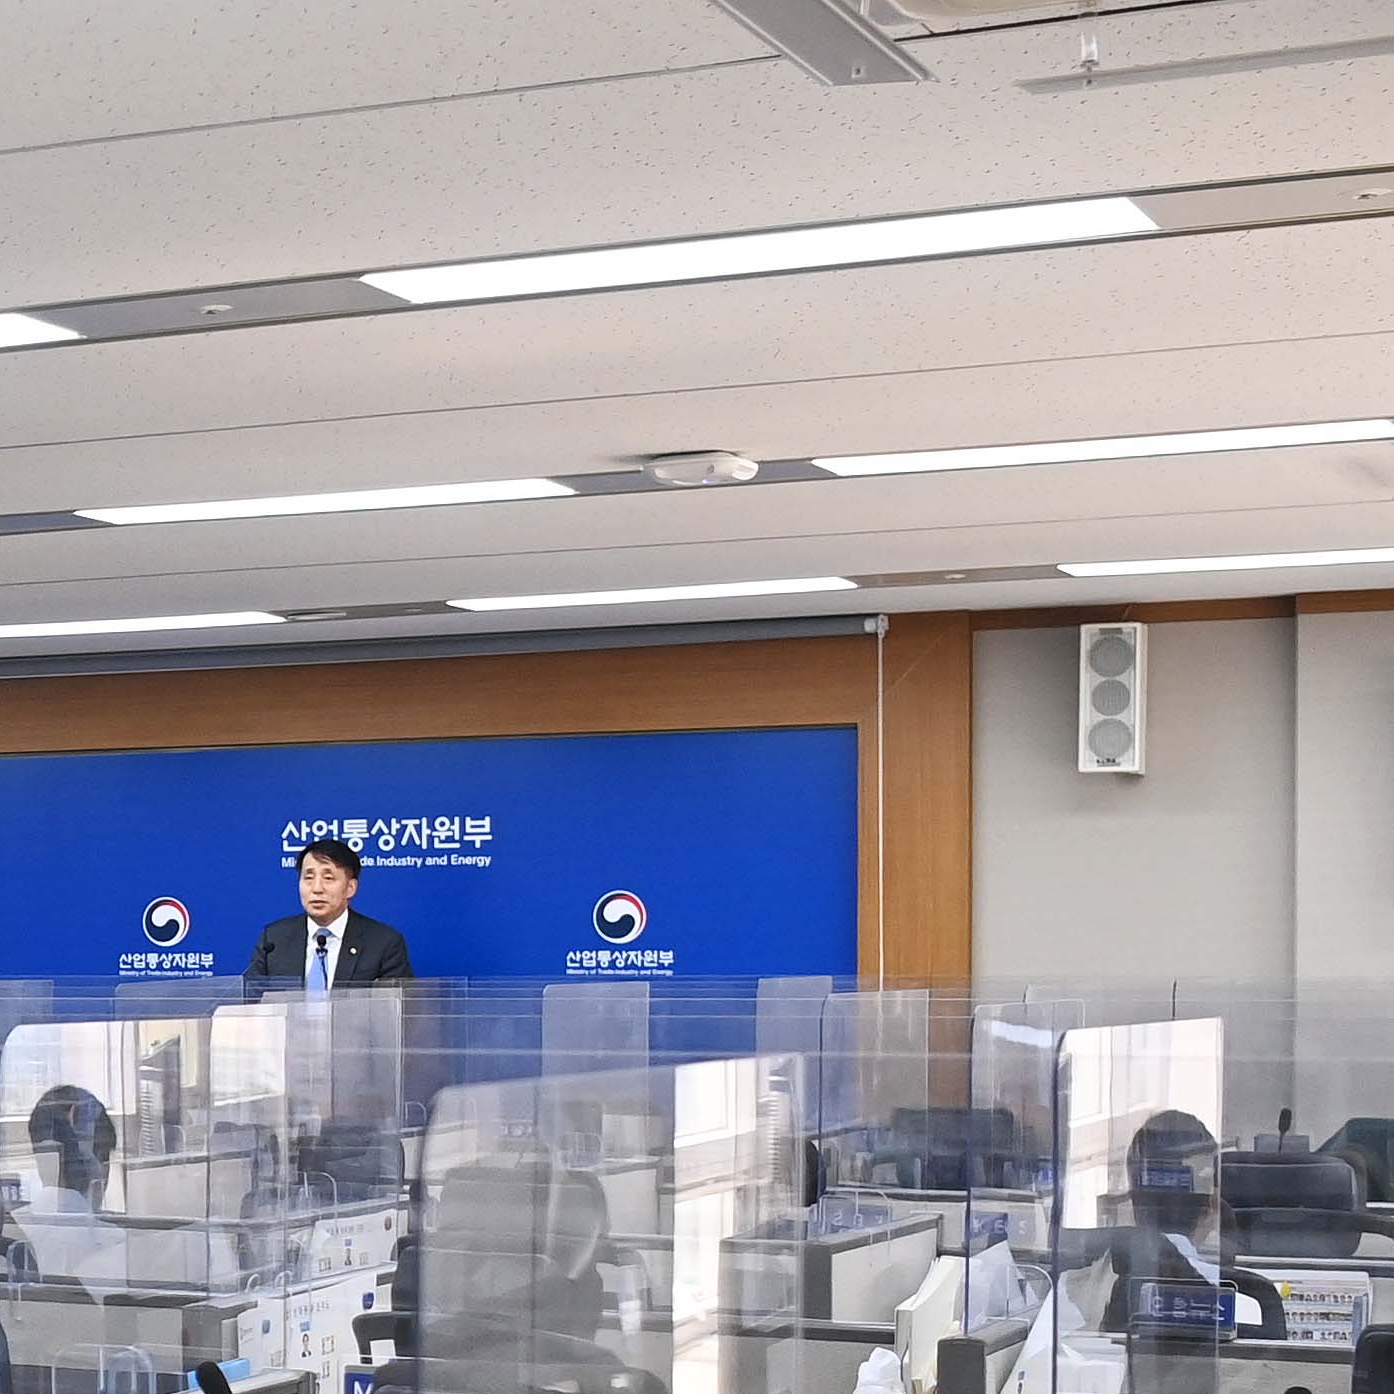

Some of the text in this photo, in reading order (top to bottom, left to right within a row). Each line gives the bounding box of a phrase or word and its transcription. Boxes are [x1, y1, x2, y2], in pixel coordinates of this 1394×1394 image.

[376, 855, 423, 868] Industry
[426, 855, 447, 866] and
[451, 854, 492, 868] Energy
[119, 952, 214, 969] 산업통상자원부
[566, 950, 674, 968] 산업통상자원부
